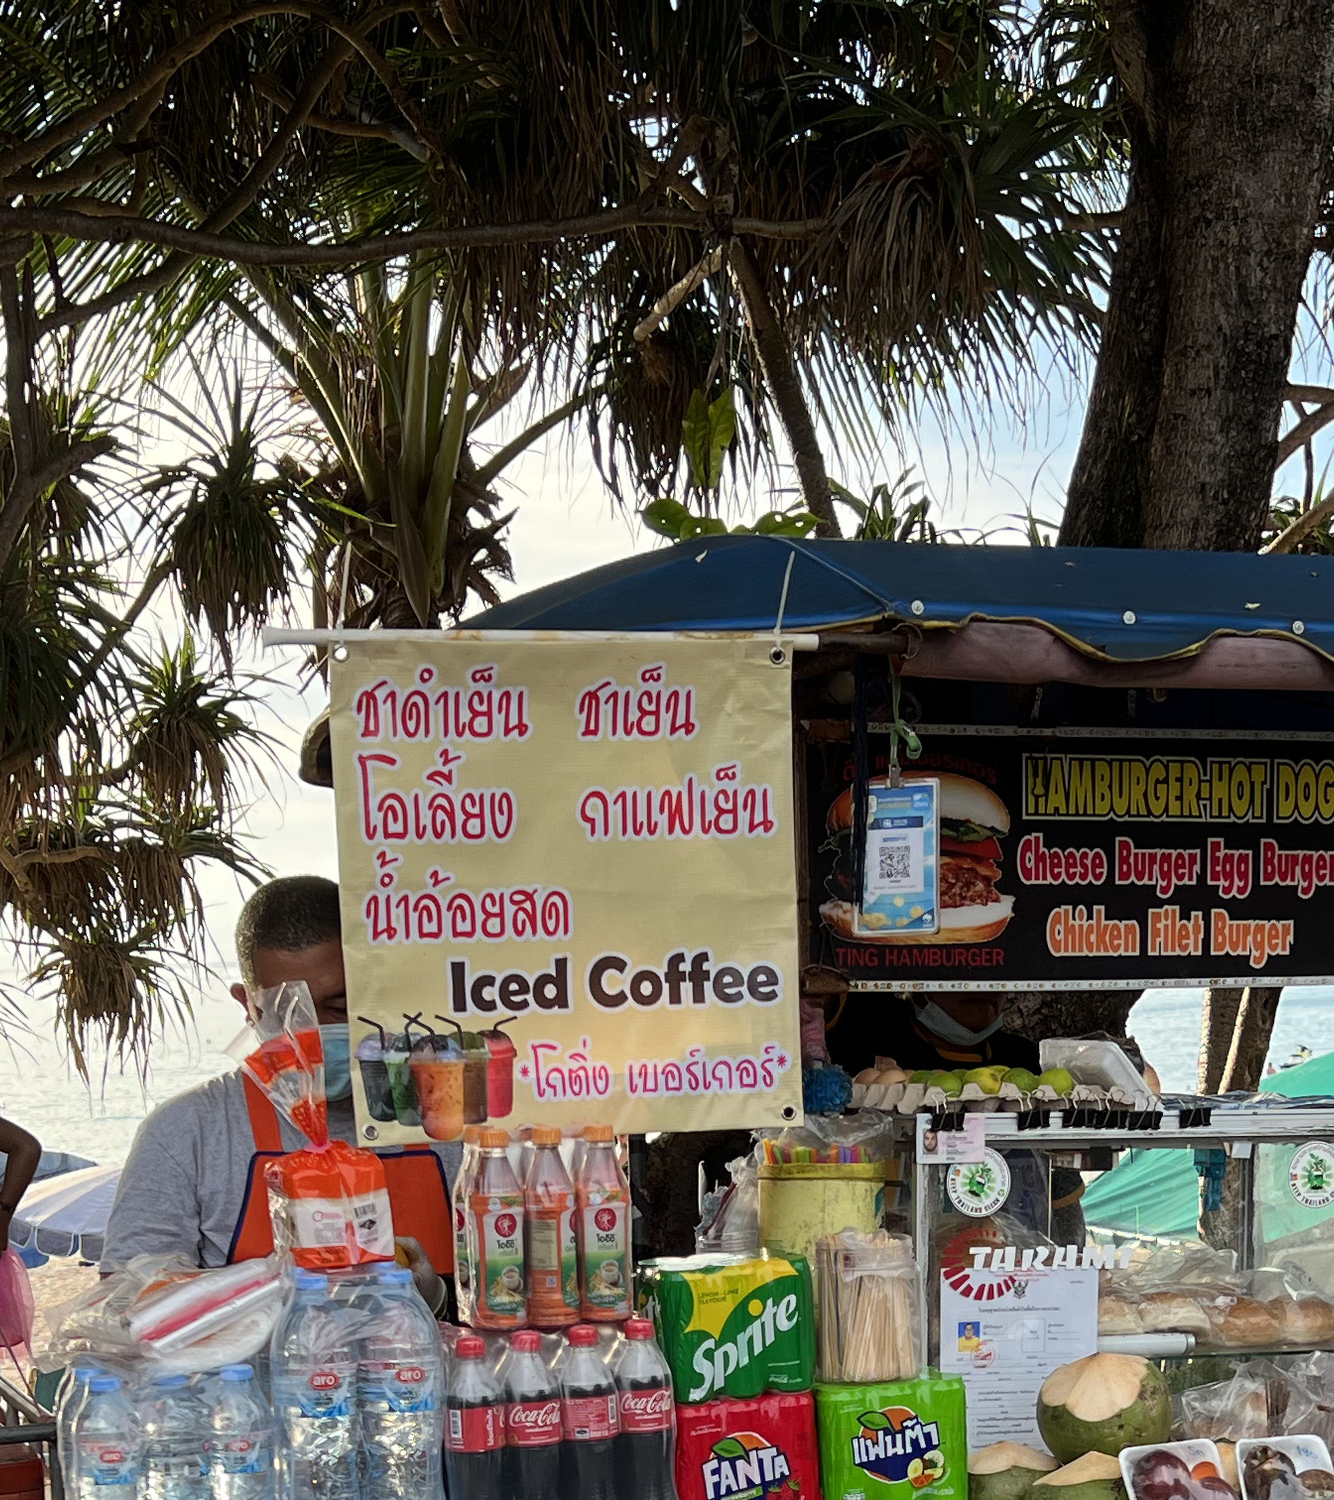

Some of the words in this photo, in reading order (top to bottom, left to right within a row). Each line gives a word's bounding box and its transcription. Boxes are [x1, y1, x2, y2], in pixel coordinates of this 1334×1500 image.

[356, 667, 528, 739] ชาดำเย็น
[579, 667, 696, 739] ชาเย็น
[357, 749, 513, 841] โอเลี้ยง
[579, 765, 773, 837] กาแฟเย็น
[365, 852, 568, 941] น้ำอ้อยสด
[1020, 837, 1105, 883] Cheese
[1118, 841, 1198, 895] Burger
[1209, 841, 1251, 897] Egg
[836, 948, 878, 967] TING
[885, 948, 1005, 967] HAMBURGER
[1049, 907, 1140, 955] Chicken
[1149, 909, 1203, 955] Filet
[1212, 911, 1294, 967] Burger
[451, 958, 567, 1012] Iced
[589, 952, 779, 1007] Coffee
[399, 1368, 423, 1382] aro
[688, 1293, 798, 1401] Sprite
[313, 1373, 337, 1388] aro
[702, 1446, 789, 1500] FANTA
